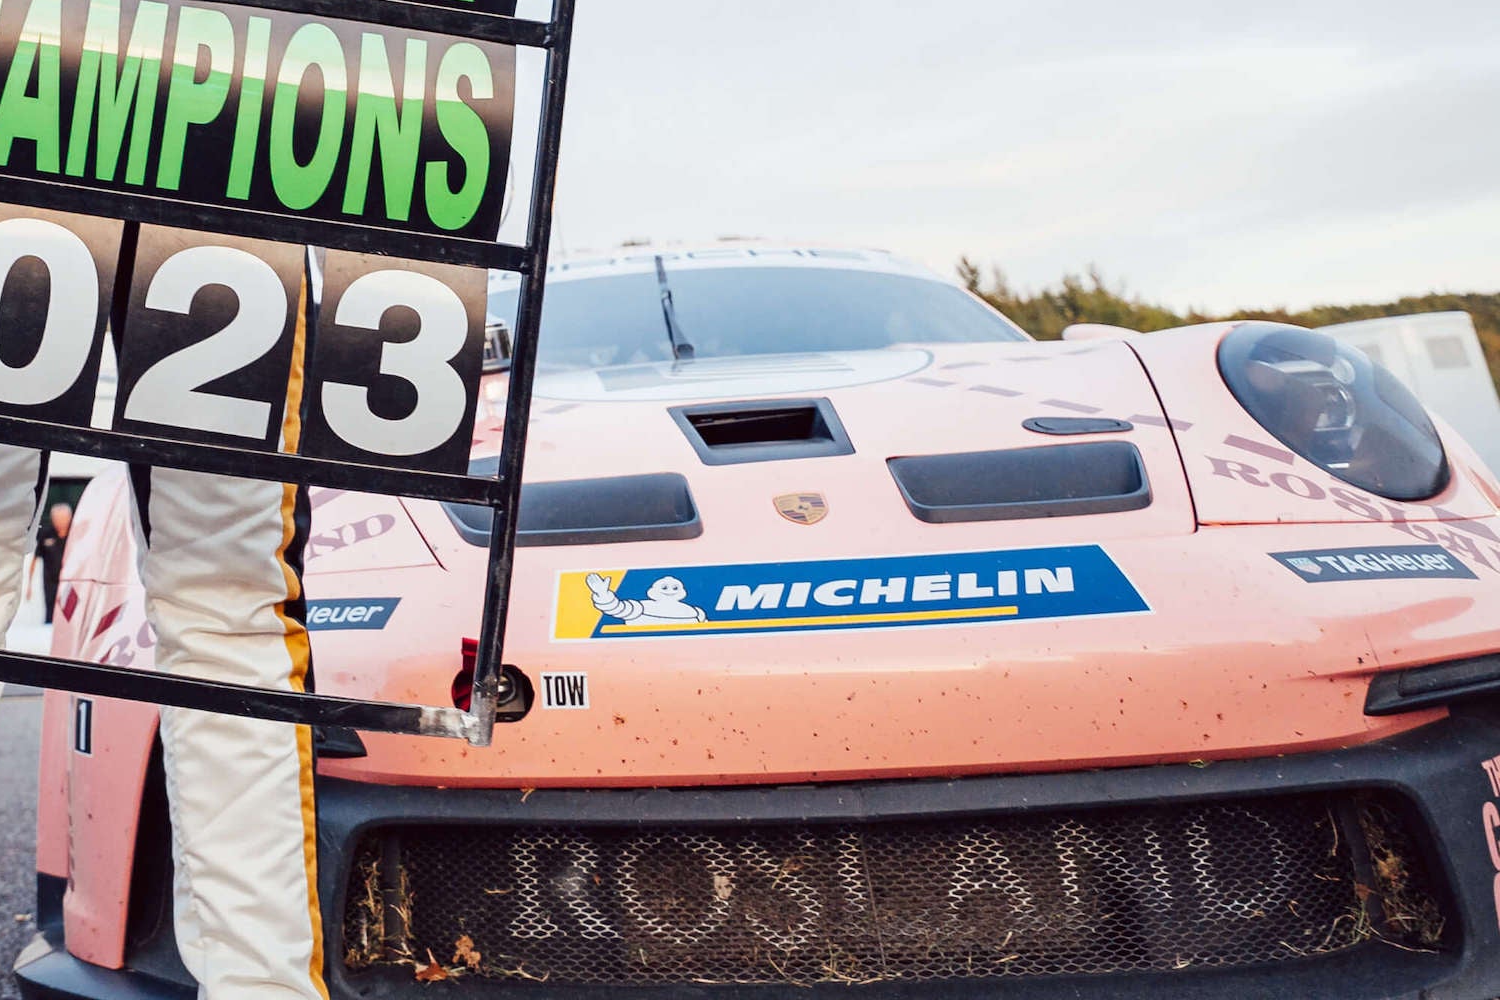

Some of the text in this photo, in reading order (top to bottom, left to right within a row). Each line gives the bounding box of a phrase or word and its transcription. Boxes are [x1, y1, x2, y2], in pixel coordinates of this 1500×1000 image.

[1204, 454, 1500, 575] ROSLA
[715, 567, 1075, 612] MICHELIN
[543, 674, 587, 706] TOW
